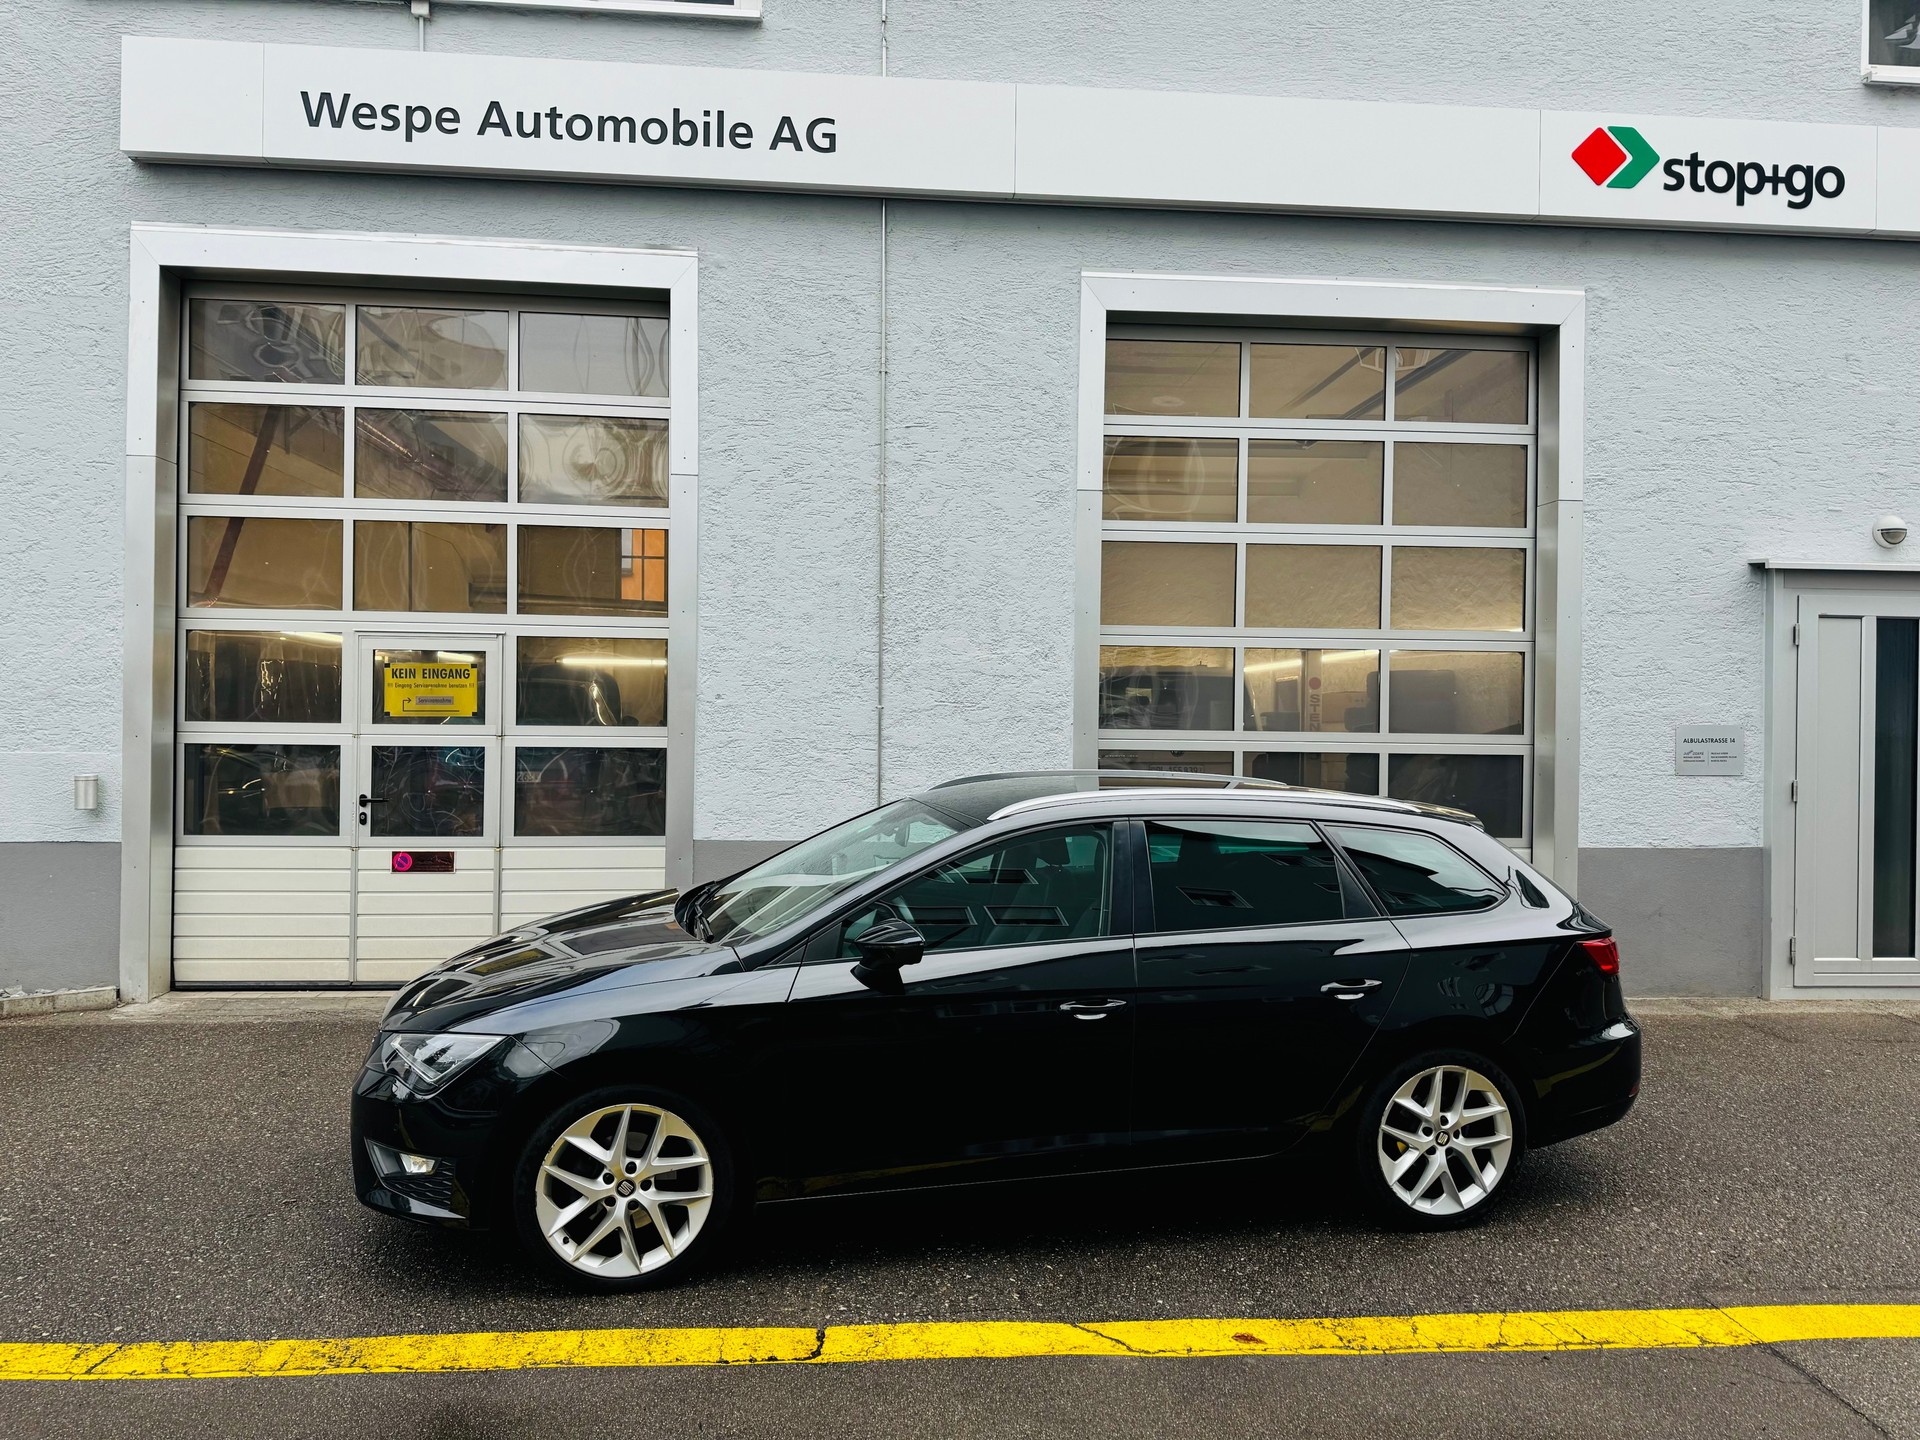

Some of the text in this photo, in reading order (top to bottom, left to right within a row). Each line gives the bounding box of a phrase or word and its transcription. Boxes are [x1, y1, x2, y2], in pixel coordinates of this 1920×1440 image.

[300, 90, 838, 154] Wespe Automobile AG
[1663, 151, 1846, 210] stop+go
[391, 668, 471, 679] KEIN EINGANG
